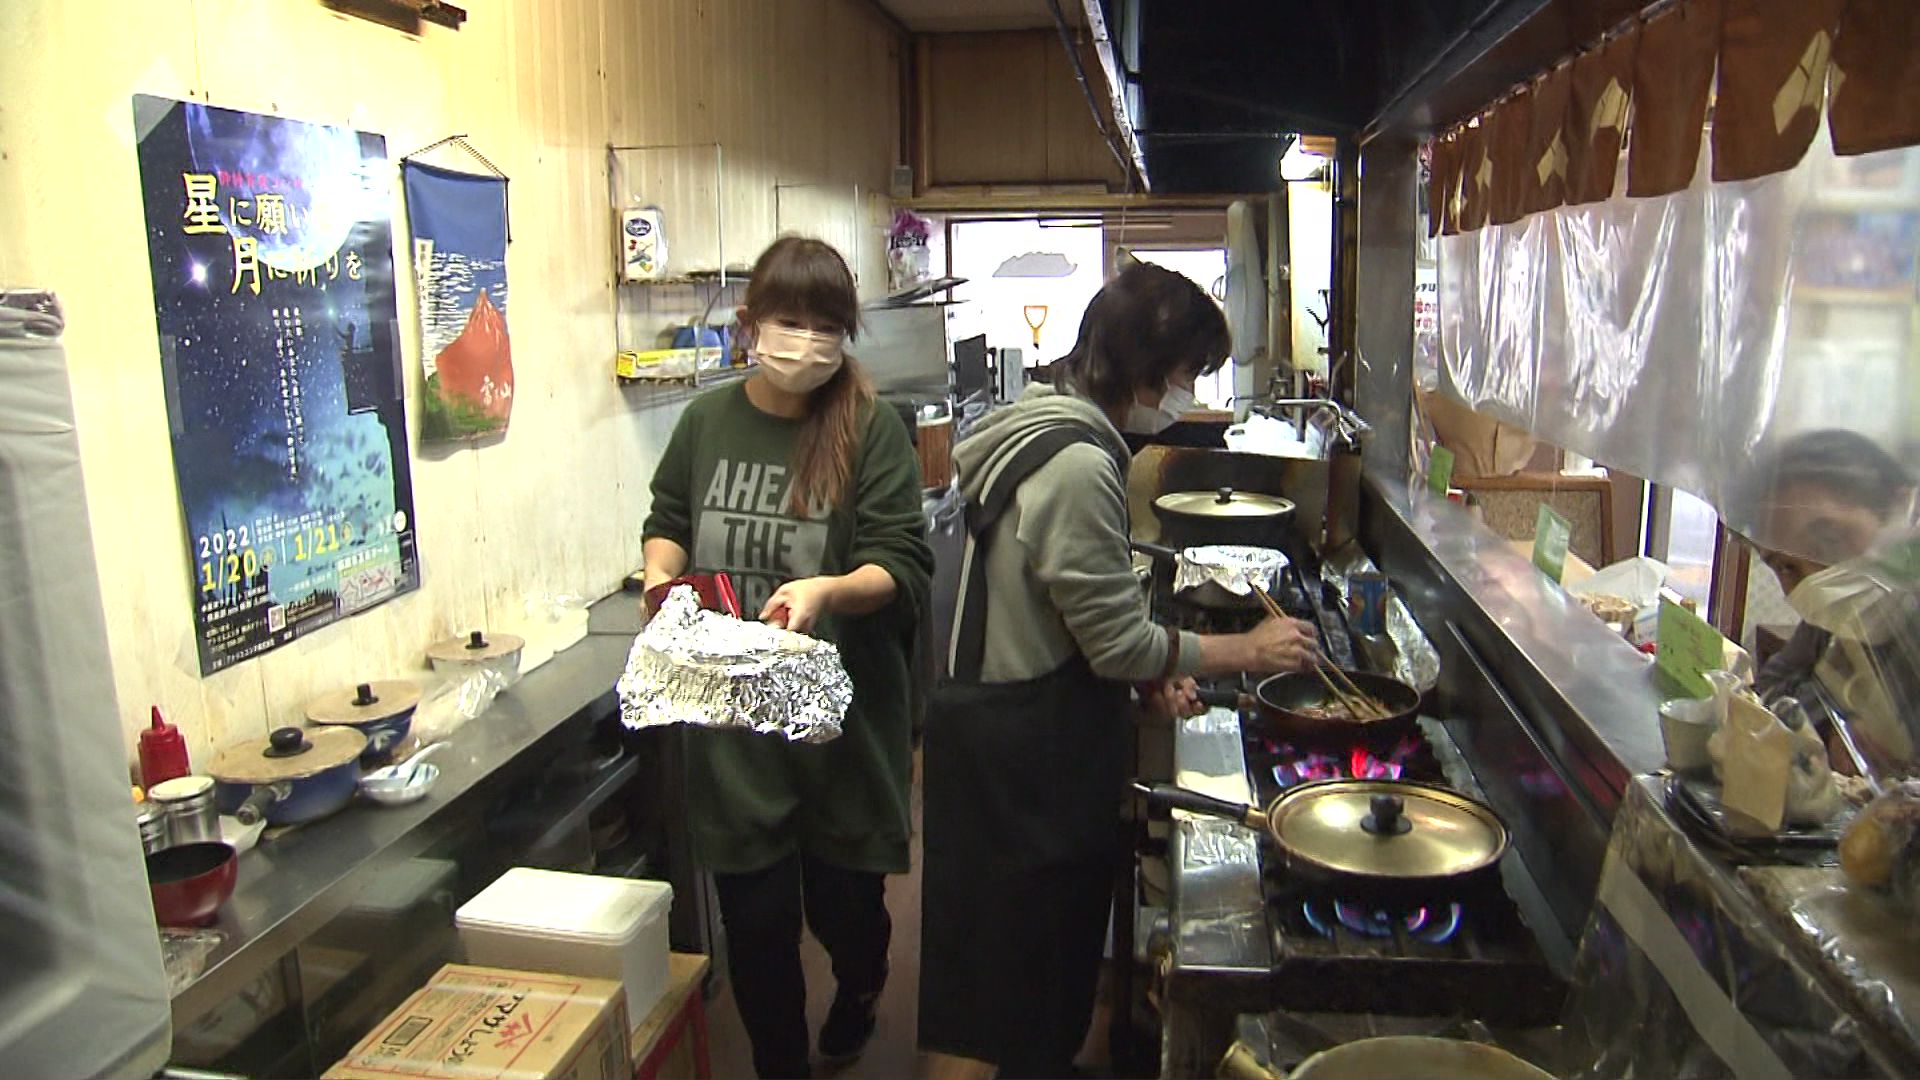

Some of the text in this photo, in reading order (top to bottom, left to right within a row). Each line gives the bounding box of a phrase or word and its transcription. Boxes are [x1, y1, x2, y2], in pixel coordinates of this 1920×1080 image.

[183, 173, 334, 234] 星に願い
[200, 525, 250, 558] 2022
[295, 524, 339, 561] 1/21
[723, 517, 797, 575] THE
[202, 548, 256, 592] 1/20
